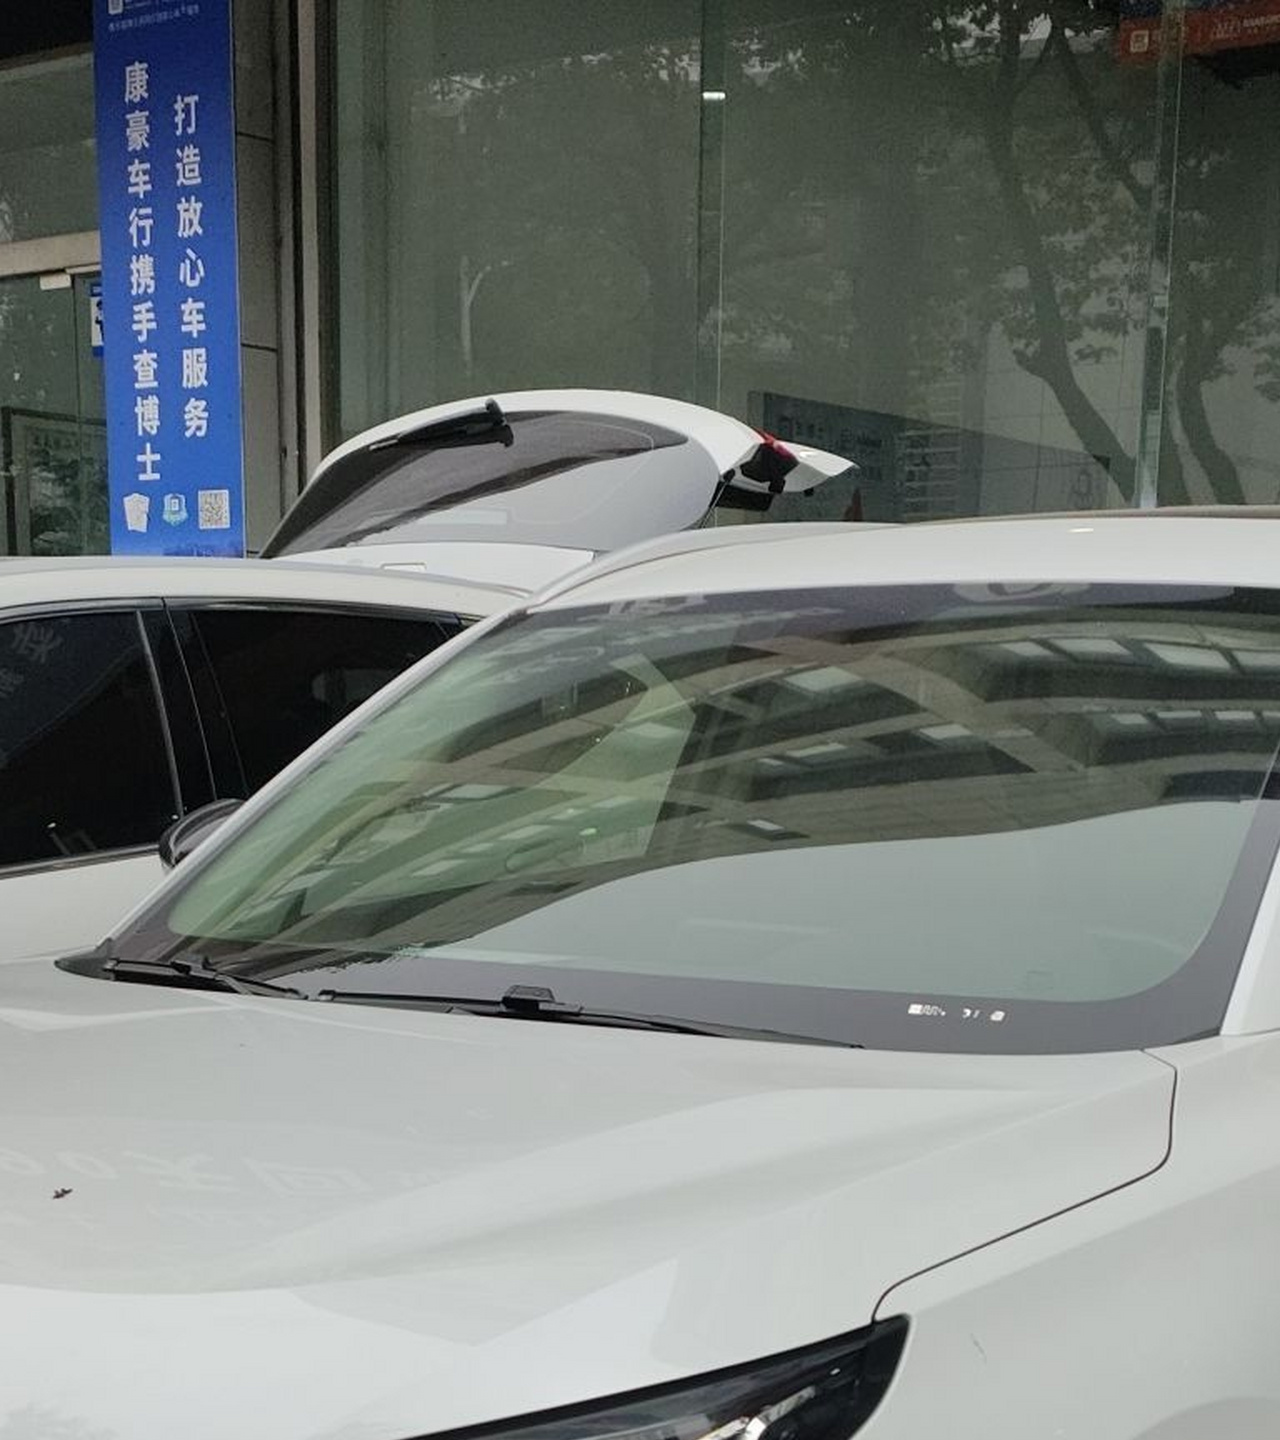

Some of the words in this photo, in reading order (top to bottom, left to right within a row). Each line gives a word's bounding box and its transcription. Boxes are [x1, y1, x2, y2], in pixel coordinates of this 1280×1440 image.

[123, 60, 161, 483] 康豪车行携手查博士
[173, 94, 210, 438] 打造放心车服务
